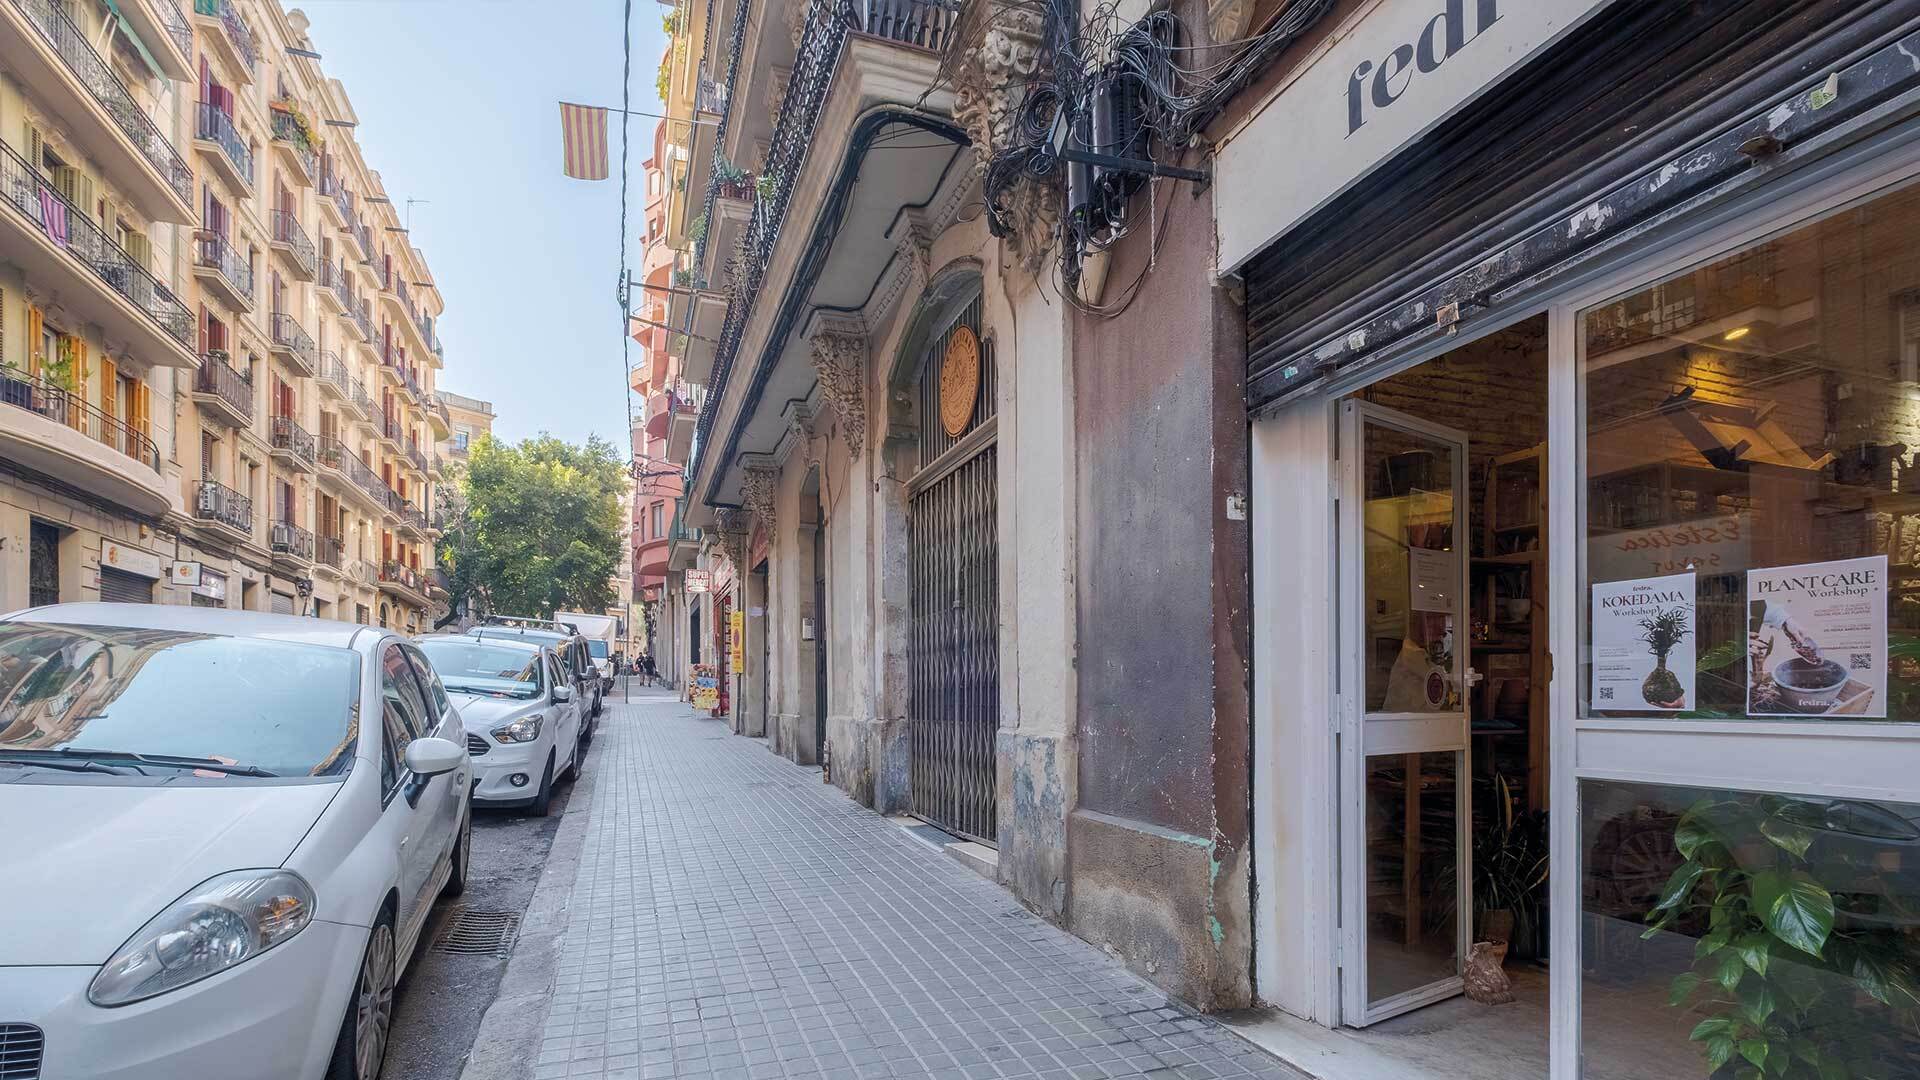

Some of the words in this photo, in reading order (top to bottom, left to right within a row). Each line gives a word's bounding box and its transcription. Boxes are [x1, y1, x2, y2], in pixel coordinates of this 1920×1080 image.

[688, 570, 709, 579] SUPER
[1758, 576, 1819, 593] PLANT
[1821, 570, 1876, 588] CARE
[1807, 586, 1868, 598] Workshop
[1602, 591, 1685, 608] KOKEDAMA
[1613, 607, 1657, 617] Workshop
